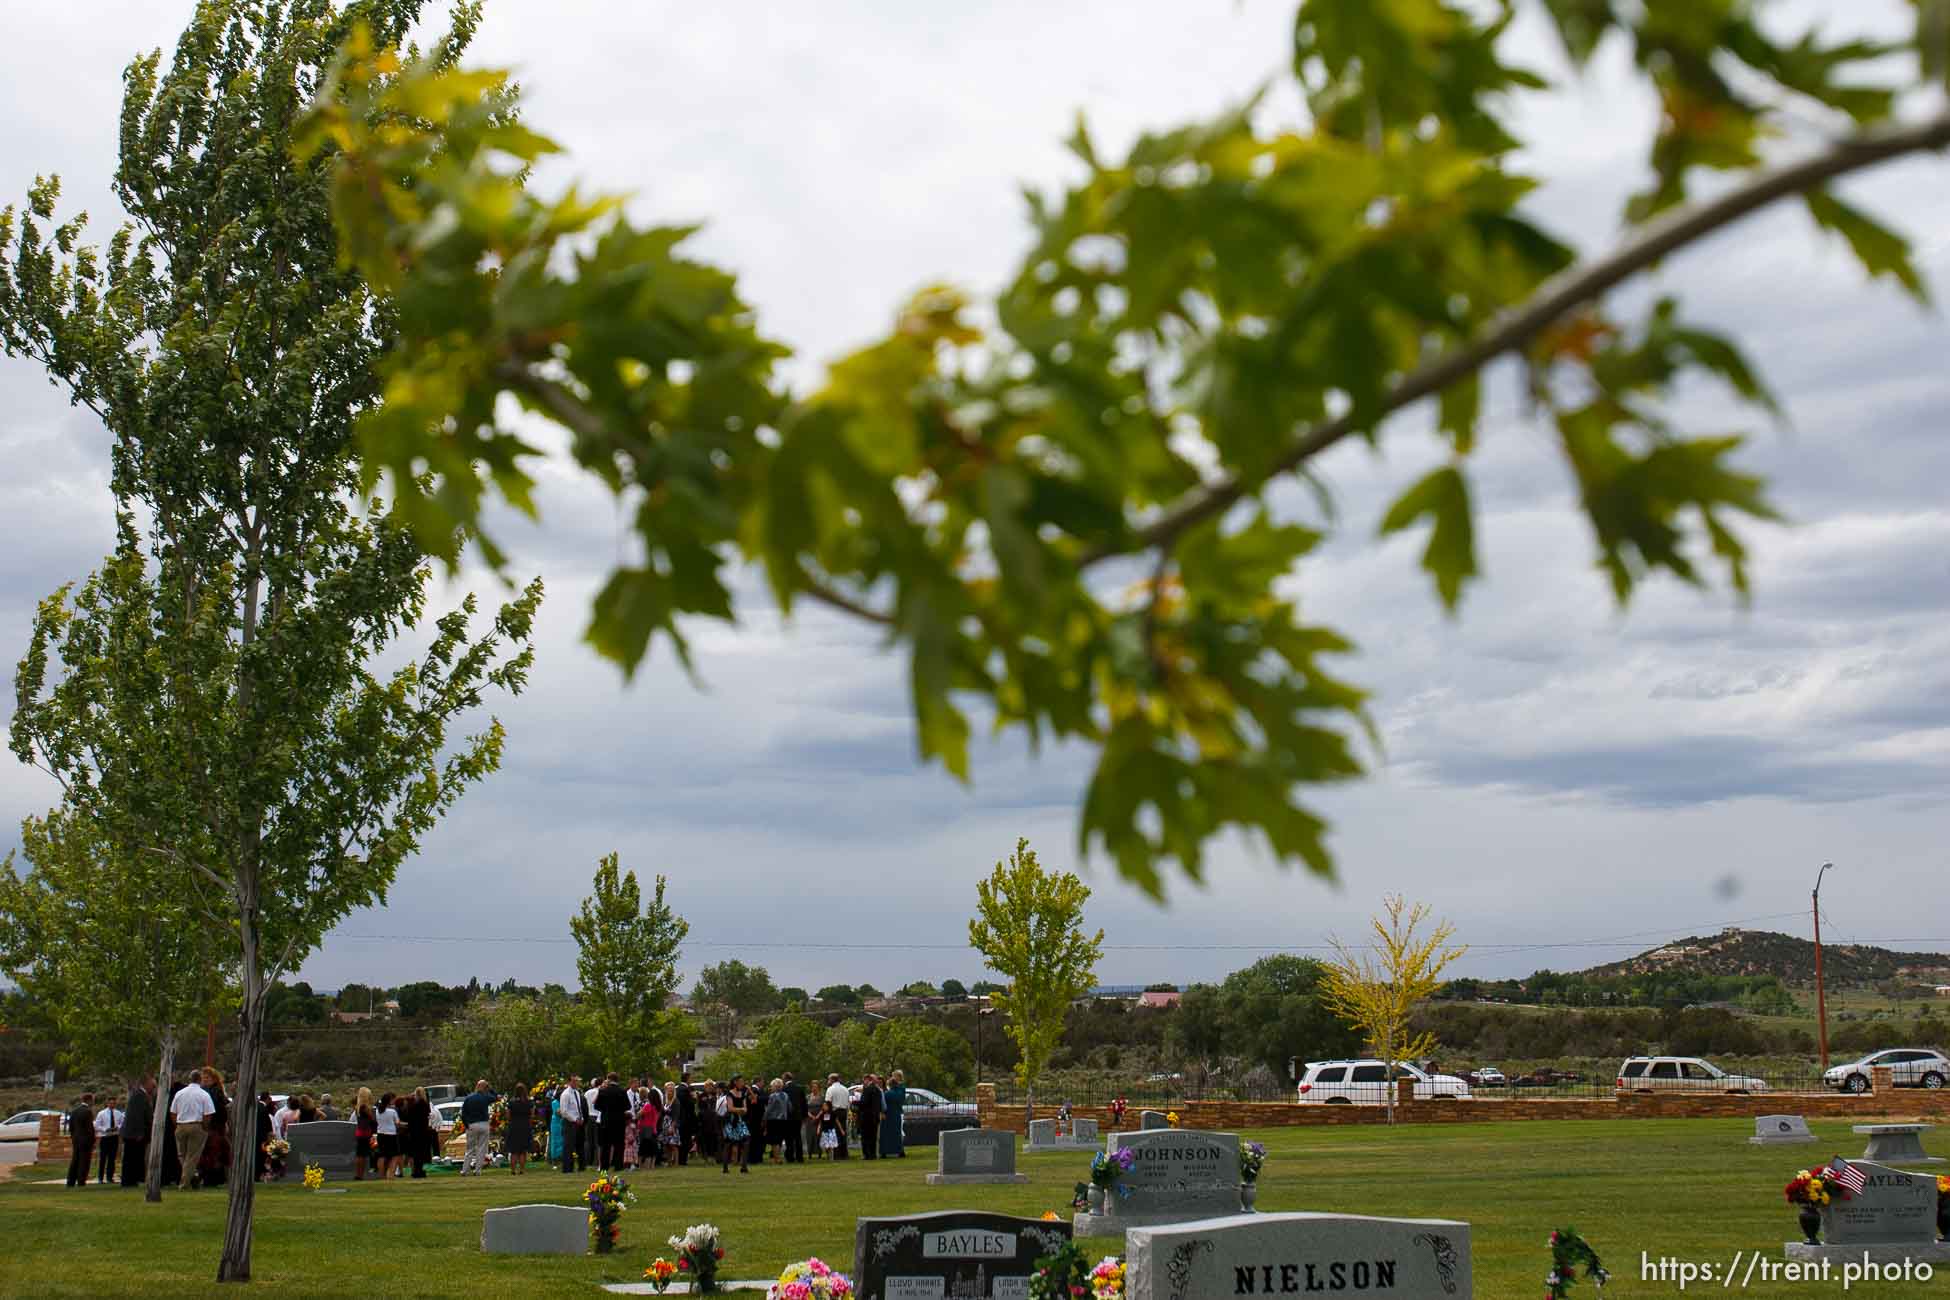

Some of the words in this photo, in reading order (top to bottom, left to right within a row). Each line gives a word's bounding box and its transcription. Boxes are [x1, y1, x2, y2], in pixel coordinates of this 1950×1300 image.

[1136, 1147, 1220, 1160] JOHNSON
[937, 1235, 1004, 1254] BAYLES
[1234, 1260, 1397, 1294] NIELSON
